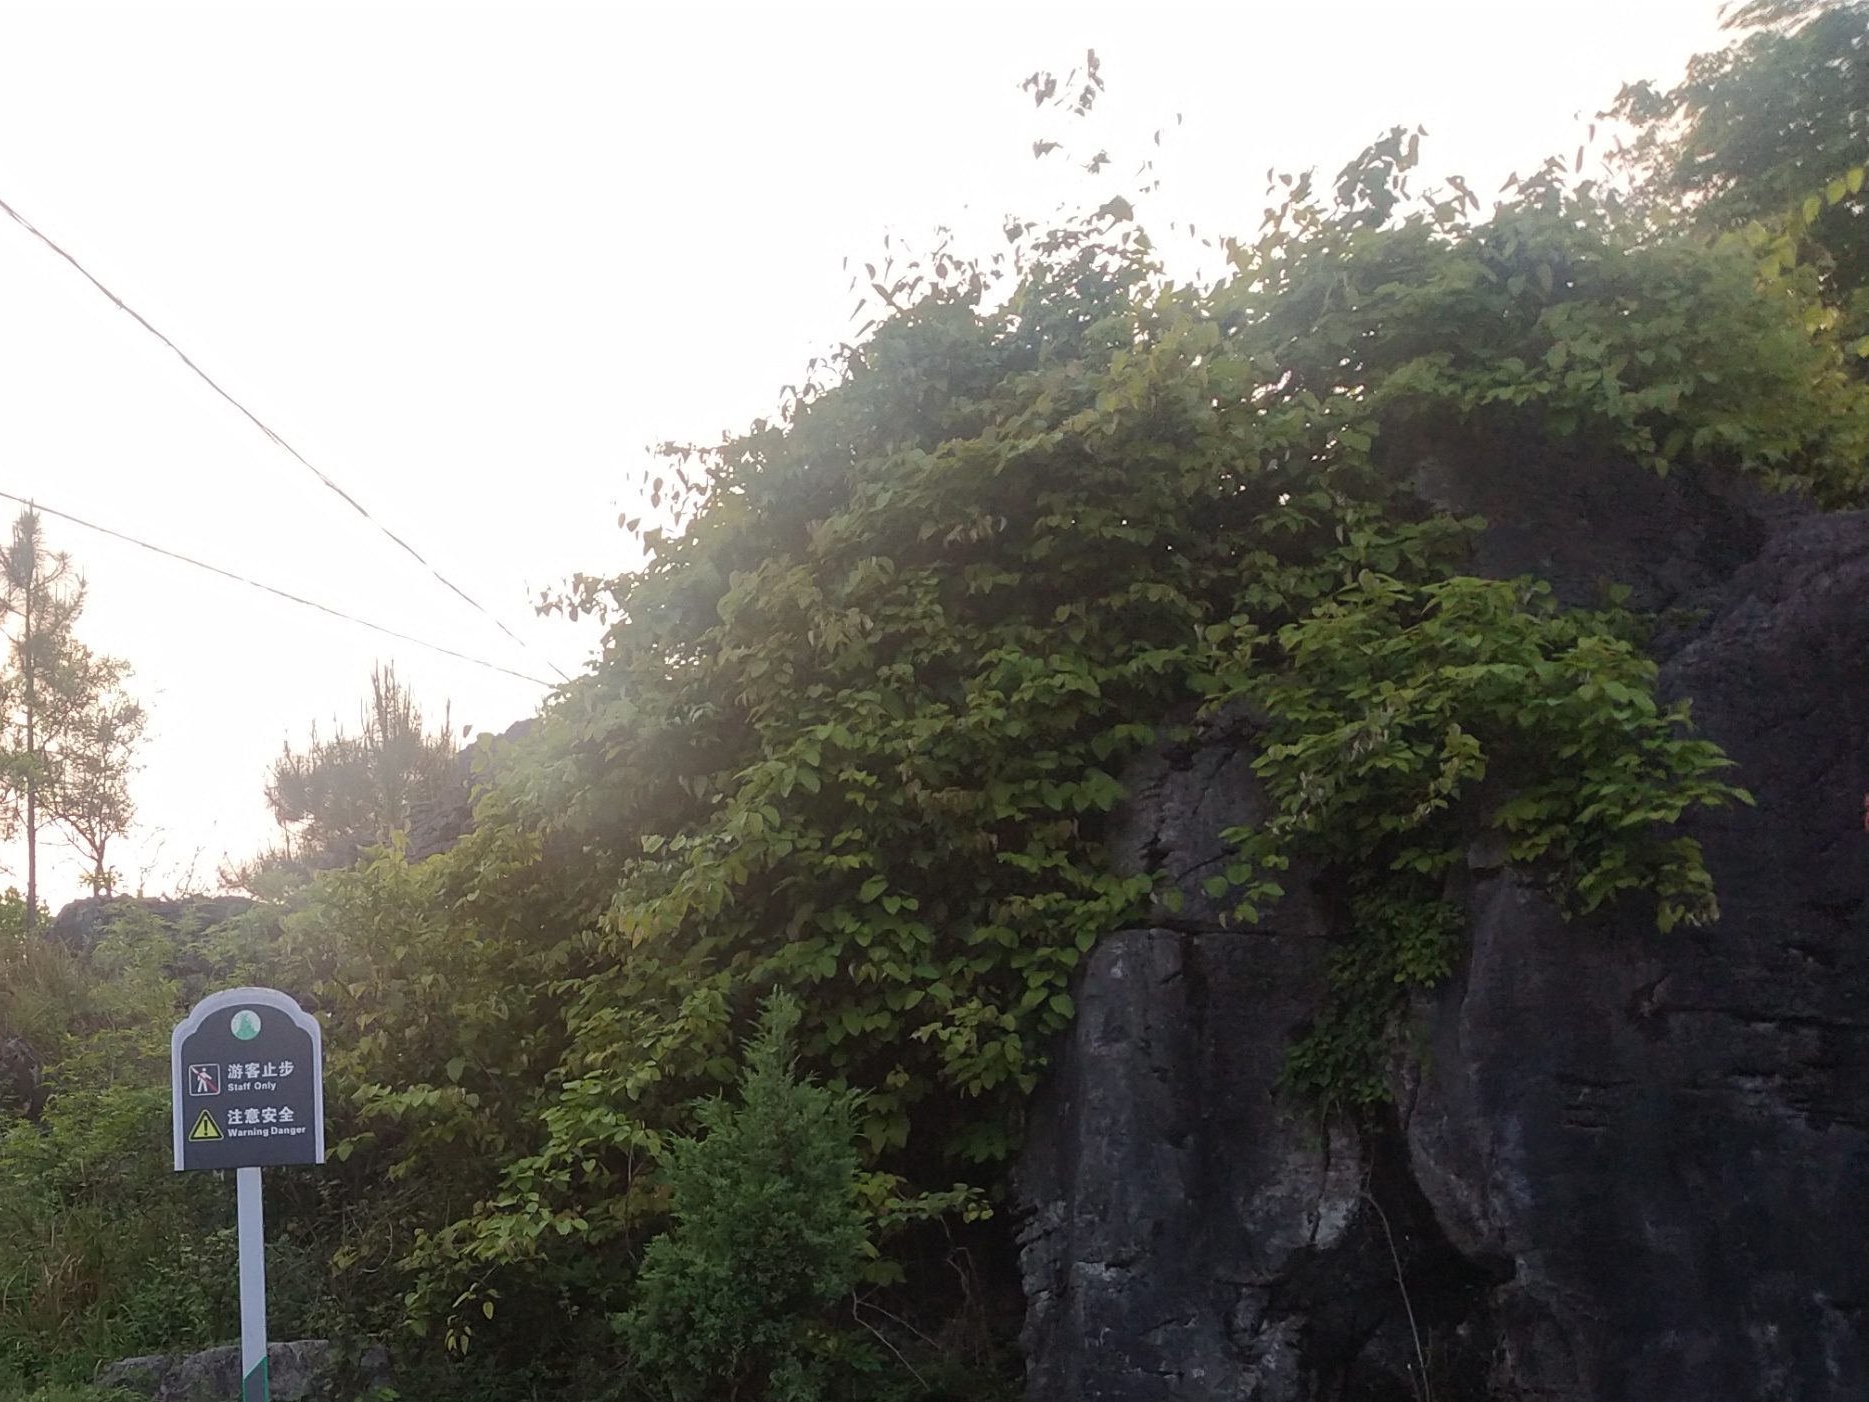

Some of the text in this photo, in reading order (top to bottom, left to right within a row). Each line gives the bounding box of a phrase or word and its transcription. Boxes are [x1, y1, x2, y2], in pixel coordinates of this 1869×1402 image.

[227, 1060, 295, 1079] 游客止步
[227, 1081, 277, 1092] Staff Only
[227, 1105, 295, 1125] 注意安全
[227, 1126, 306, 1138] Warning Danger
